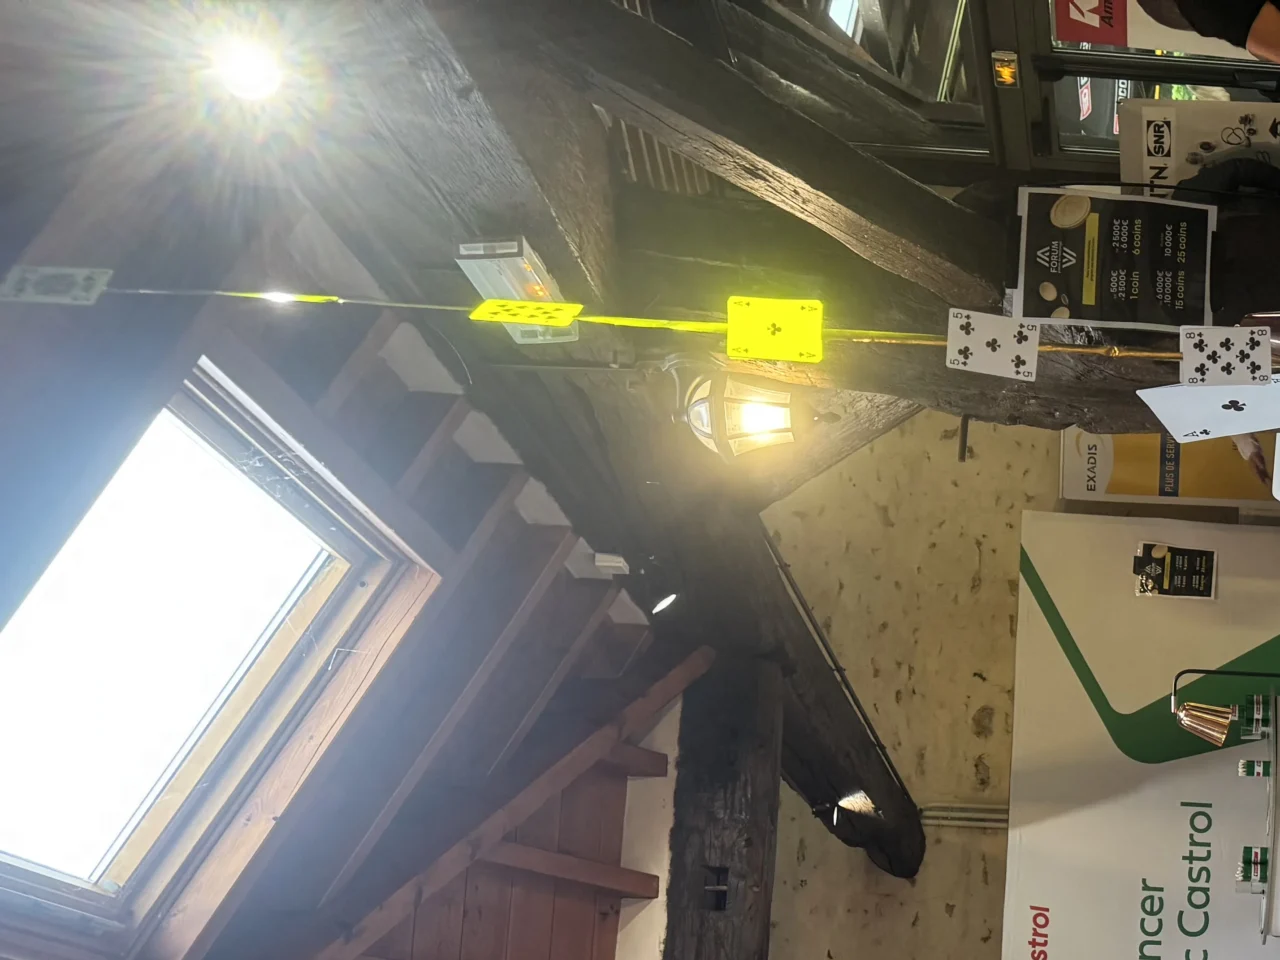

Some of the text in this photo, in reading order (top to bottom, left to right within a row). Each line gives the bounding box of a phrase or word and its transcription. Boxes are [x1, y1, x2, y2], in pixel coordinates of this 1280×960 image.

[1153, 123, 1165, 155] SNR
[1113, 219, 1121, 240] 500€
[1132, 219, 1142, 247] coins
[1177, 222, 1187, 263] 25 coins
[1050, 241, 1059, 273] FORUM
[1110, 270, 1118, 292] 500€
[1119, 269, 1127, 291] 500€
[1130, 271, 1139, 294] coin
[1175, 270, 1185, 309] 15 coins
[1022, 370, 1033, 378] 5
[1086, 443, 1097, 492] EXADIS
[1165, 461, 1175, 470] DE
[1164, 473, 1174, 492] PLUS
[1177, 801, 1213, 937] Castrol
